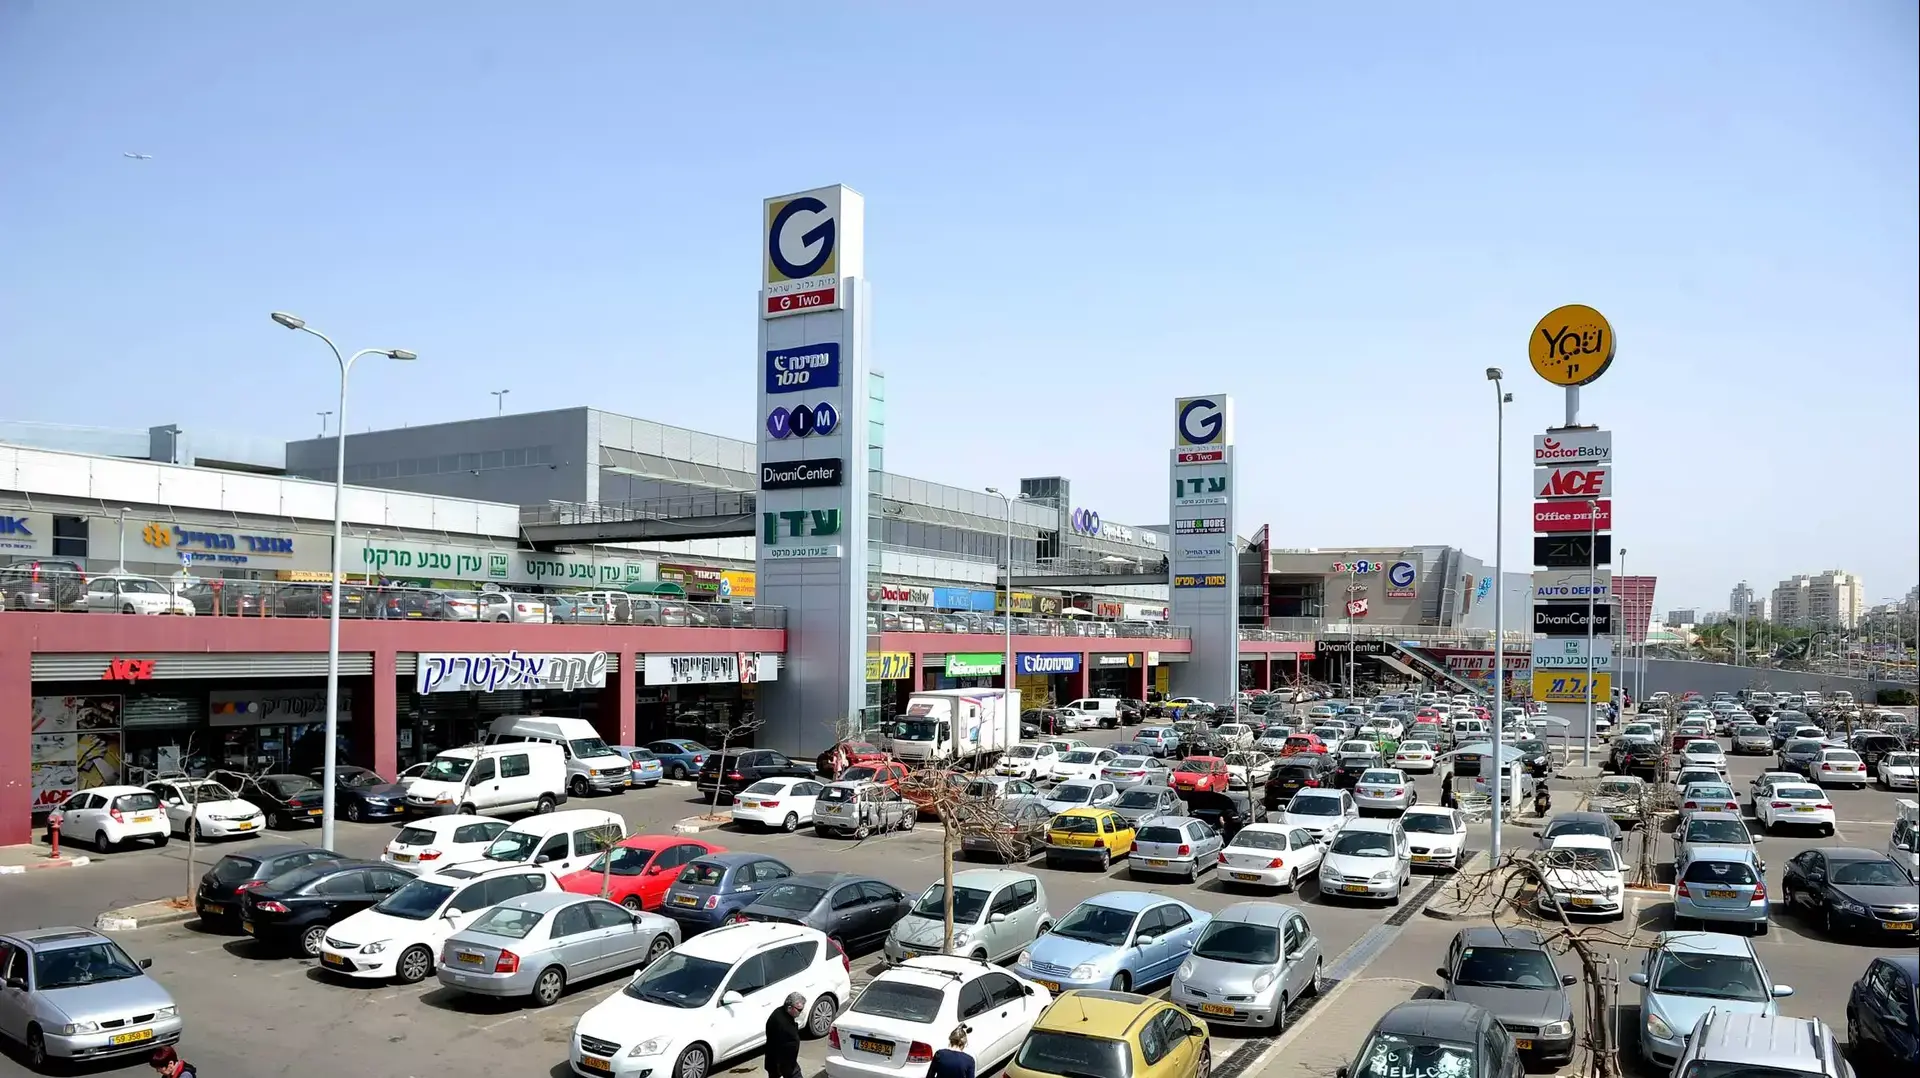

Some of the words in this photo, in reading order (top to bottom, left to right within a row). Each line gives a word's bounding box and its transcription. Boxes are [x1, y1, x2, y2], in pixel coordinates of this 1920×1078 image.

[769, 197, 835, 279] G
[780, 296, 791, 309] G
[796, 294, 821, 306] Two
[1541, 324, 1603, 359] You
[788, 353, 829, 370] עמינח
[775, 370, 810, 386] סנטר
[773, 409, 831, 431] VIM
[1179, 399, 1222, 445] G
[1185, 454, 1194, 462] G
[1535, 446, 1609, 458] DoctorBaby
[763, 465, 834, 482] DivaniCenter
[1540, 469, 1605, 495] ACE
[1176, 477, 1226, 498] עדן
[1535, 512, 1571, 521] Office
[763, 508, 842, 544] עדן
[173, 525, 236, 550] החייל
[239, 535, 294, 553] אוצר
[363, 548, 412, 571] מרקט
[417, 552, 451, 569] טבע
[491, 555, 507, 566] עדן
[771, 549, 790, 557] מרקט
[808, 548, 821, 556] עדן
[457, 554, 482, 576] עדן
[526, 560, 565, 580] מרקט
[569, 563, 596, 579] טבע
[600, 565, 621, 582] עדן
[627, 565, 640, 574] עדן
[1388, 561, 1416, 588] G
[1537, 587, 1569, 595] AUTO
[1571, 586, 1607, 595] DEPOT
[1318, 641, 1380, 653] DivaniCenter
[101, 656, 156, 680] ACE
[1451, 657, 1483, 669] האדום
[1487, 657, 1530, 669] הפירט
[1536, 656, 1564, 666] מרקט
[1567, 656, 1588, 665] טבע
[423, 652, 544, 694] אלקטריק
[549, 651, 606, 691] שקם
[671, 674, 733, 683] sport
[34, 789, 72, 805] ACE
